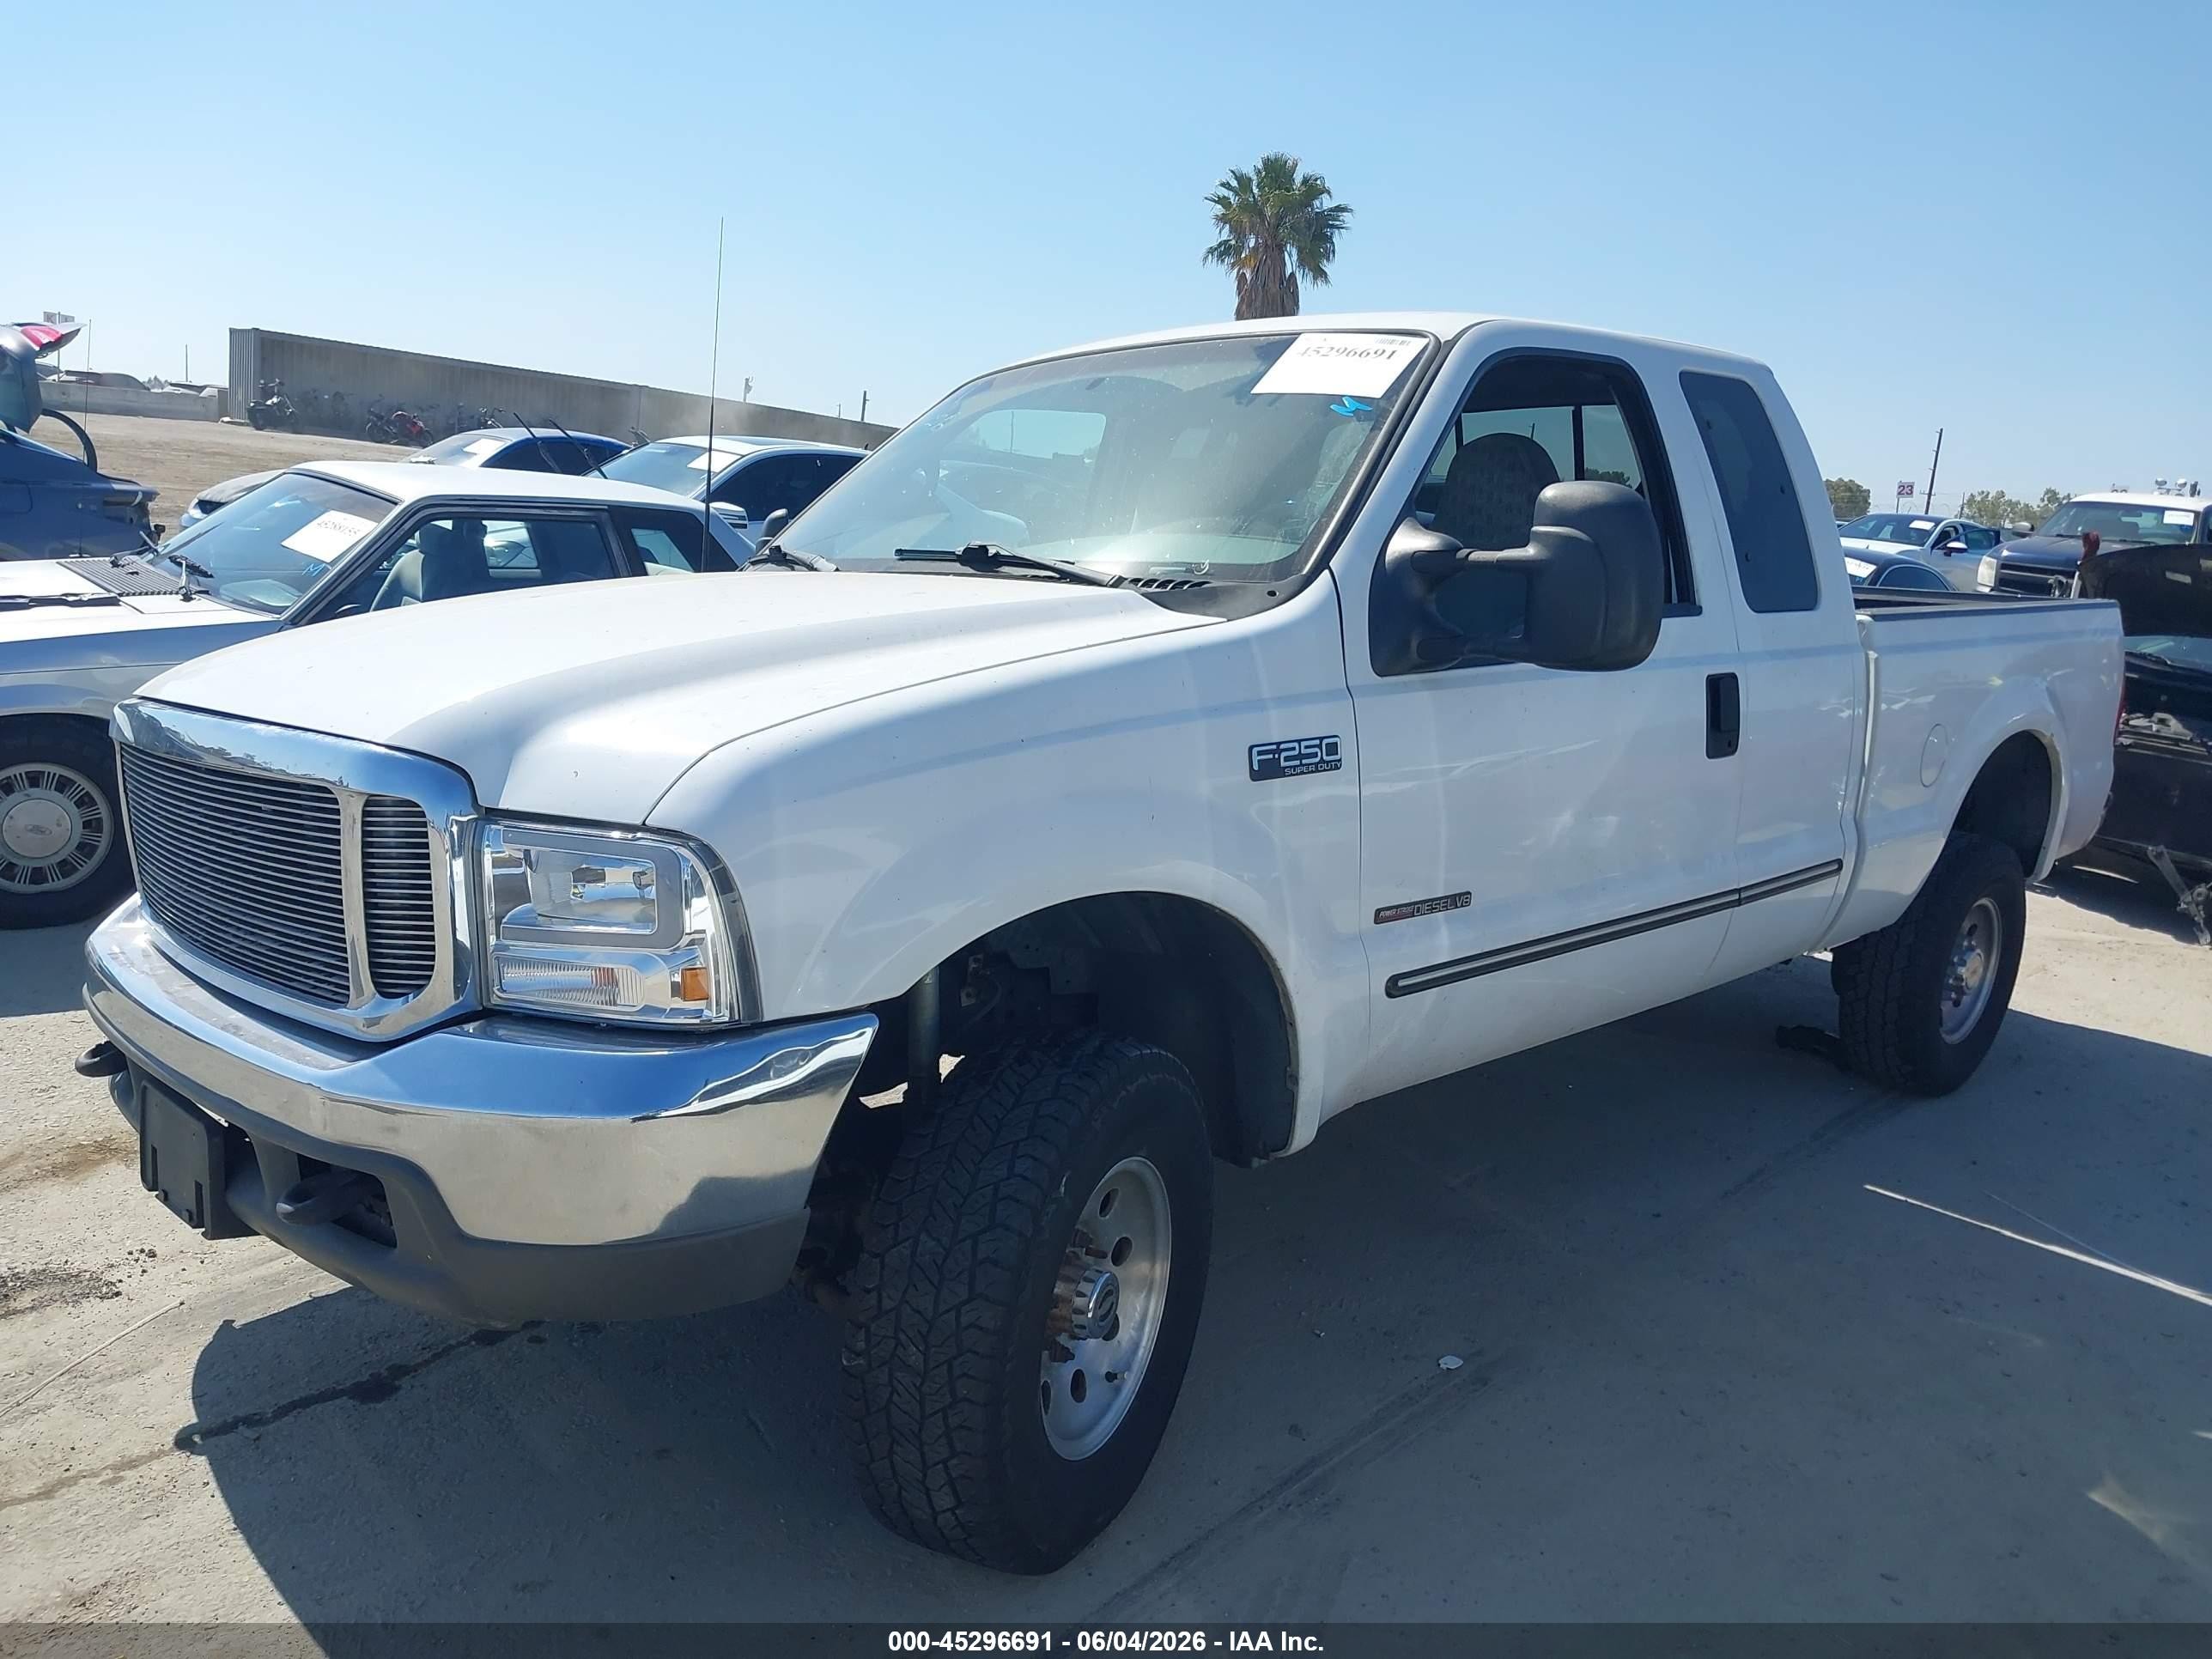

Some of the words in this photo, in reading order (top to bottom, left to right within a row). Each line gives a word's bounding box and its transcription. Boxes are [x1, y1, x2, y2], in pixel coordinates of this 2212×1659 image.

[1897, 484, 1914, 495] 23
[1251, 737, 1341, 771] F-250
[1285, 765, 1316, 776] SUPER
[1317, 761, 1341, 770] DUTY
[1413, 899, 1455, 915] DIESEL
[1455, 894, 1471, 908] V8
